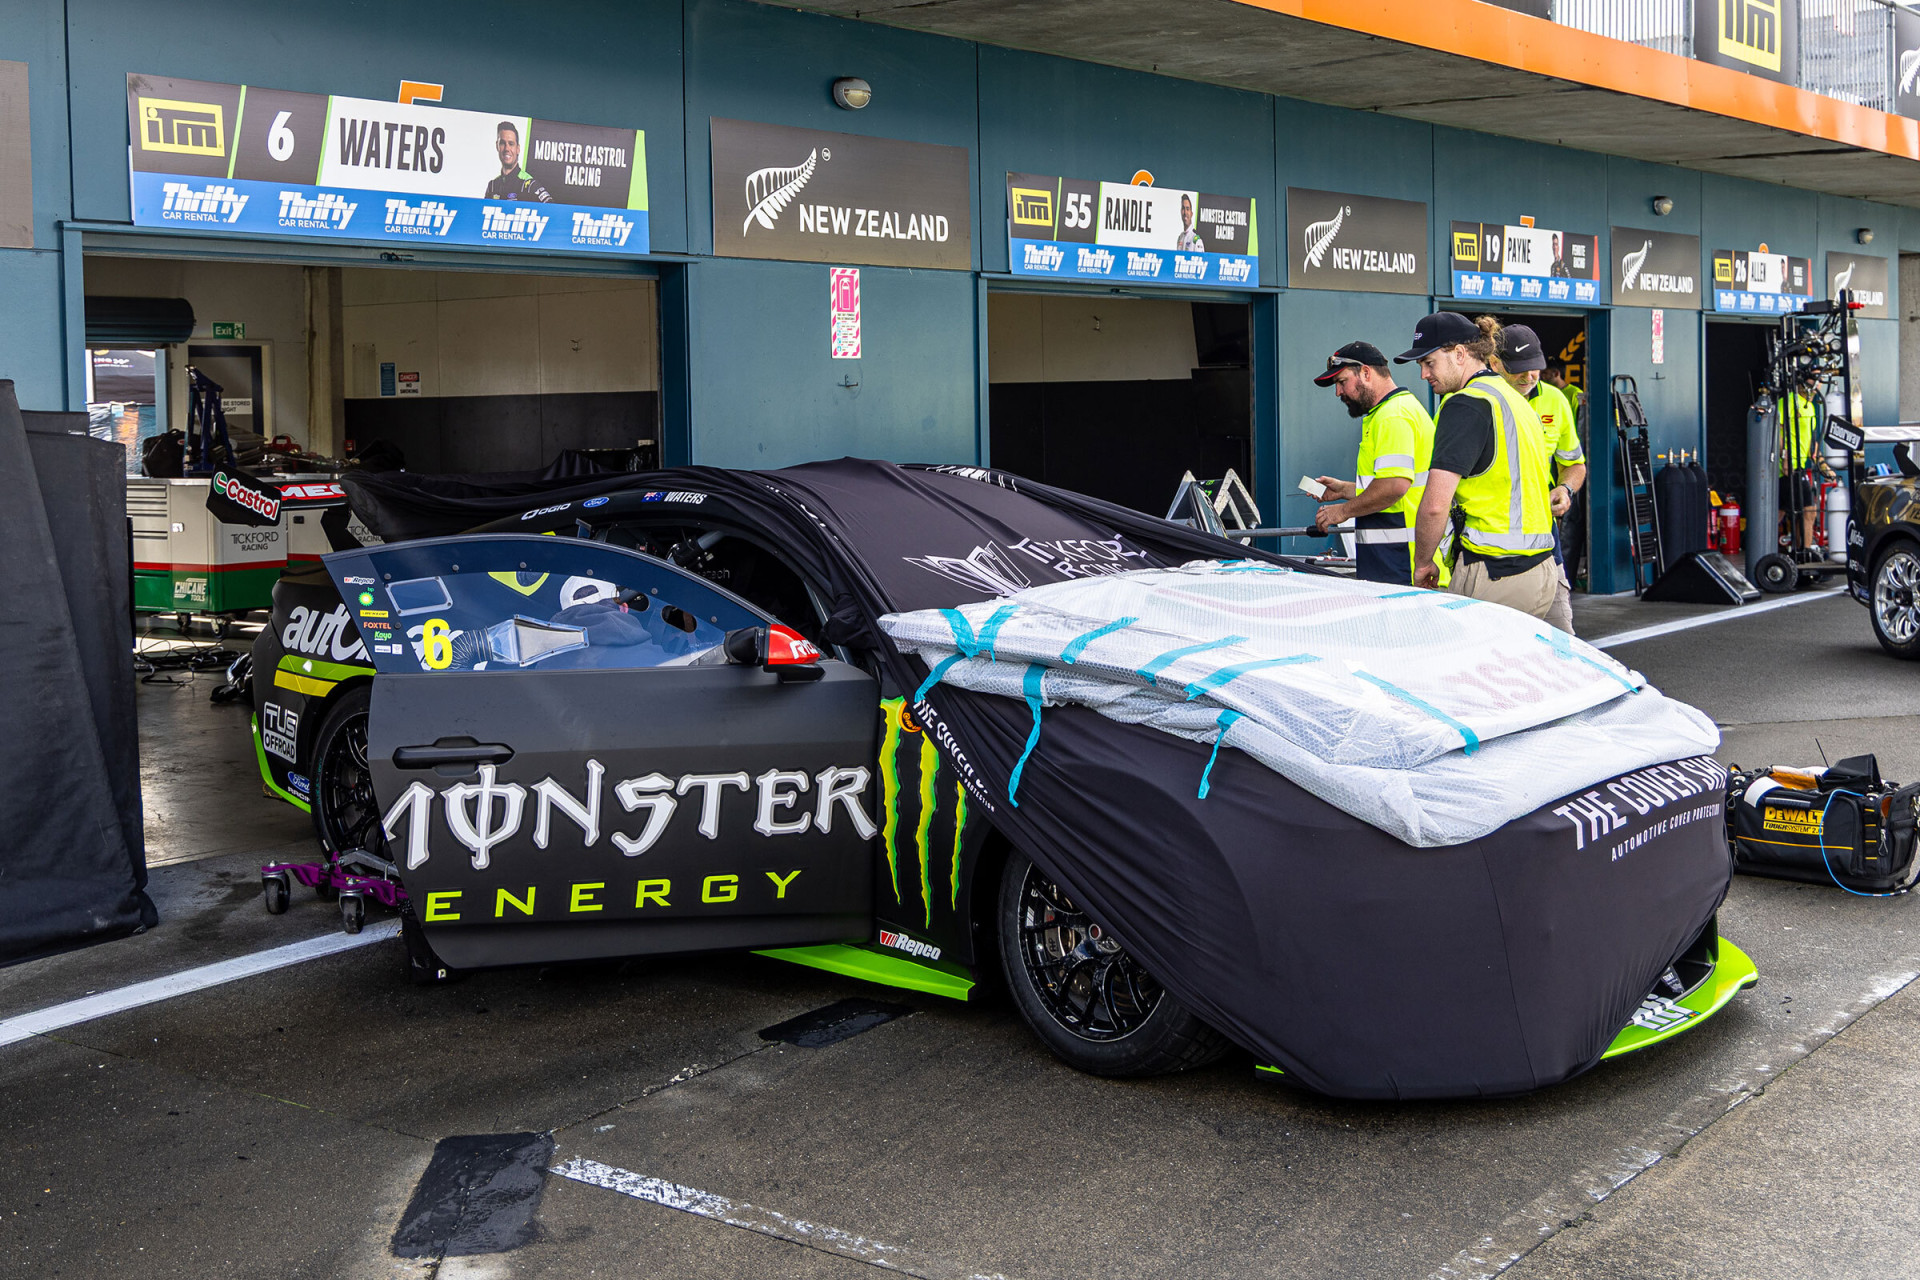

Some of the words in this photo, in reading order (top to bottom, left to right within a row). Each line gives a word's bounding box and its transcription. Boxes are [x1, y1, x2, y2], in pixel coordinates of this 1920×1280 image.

[267, 111, 295, 161] 6
[339, 117, 446, 173] WATERS
[534, 140, 582, 163] MONSTER
[585, 145, 627, 168] CASTROL
[565, 165, 601, 187] RACING
[162, 182, 249, 223] Thrifty
[278, 191, 358, 230] Thrifty
[1064, 192, 1092, 229] 55
[1105, 197, 1153, 233] RANDLE
[162, 211, 182, 220] CAR
[184, 212, 219, 222] RENTAL
[279, 218, 296, 227] CAR
[298, 220, 330, 229] RENTAL
[385, 199, 457, 236] Thrifty
[385, 224, 401, 233] CAR
[403, 226, 432, 235] RENTAL
[482, 206, 549, 241] Thrifty
[572, 212, 634, 246] Thrifty
[799, 203, 851, 236] NEW
[855, 208, 949, 242] ZEALAND
[1200, 207, 1225, 224] MONSTER
[1225, 210, 1247, 226] CASTROL
[482, 231, 497, 239] CAR
[499, 232, 525, 241] RENTAL
[587, 238, 612, 246] RENTAL
[1215, 224, 1235, 240] RACING
[1024, 244, 1064, 271] Thrifty
[1333, 248, 1362, 271] NEW
[1363, 251, 1416, 274] ZEALAND
[1485, 234, 1500, 262] 19
[1507, 237, 1531, 264] PAYNE
[1077, 248, 1115, 275] Thrifty
[1127, 251, 1163, 277] Thrifty
[1174, 255, 1208, 280] Thrifty
[1219, 258, 1251, 283] Thrifty
[1735, 260, 1747, 282] 26
[1751, 261, 1766, 282] ALLEN
[1640, 272, 1659, 291] NEW
[1659, 274, 1693, 294] ZEALAND
[215, 326, 232, 335] Exit
[226, 478, 280, 520] Castrol
[663, 491, 708, 504] WATERS
[231, 531, 279, 545] TICKFORD
[241, 543, 269, 551] RACING
[174, 581, 207, 598] CHICANE
[190, 594, 206, 602] TOOLS
[363, 621, 391, 630] FOXTEL
[374, 631, 392, 641] Kayo
[423, 618, 453, 670] 6
[265, 703, 298, 740] TUS
[264, 734, 297, 760] OFFROAD
[382, 758, 878, 870] MONSTER
[1552, 790, 1627, 851] THE
[1606, 764, 1703, 816] COVER
[1611, 819, 1667, 862] AUTOMOTIVE
[1670, 810, 1691, 830] COVER
[1692, 803, 1720, 822] PROTECTION
[424, 870, 802, 922] ENERGY
[895, 932, 942, 961] Repco
